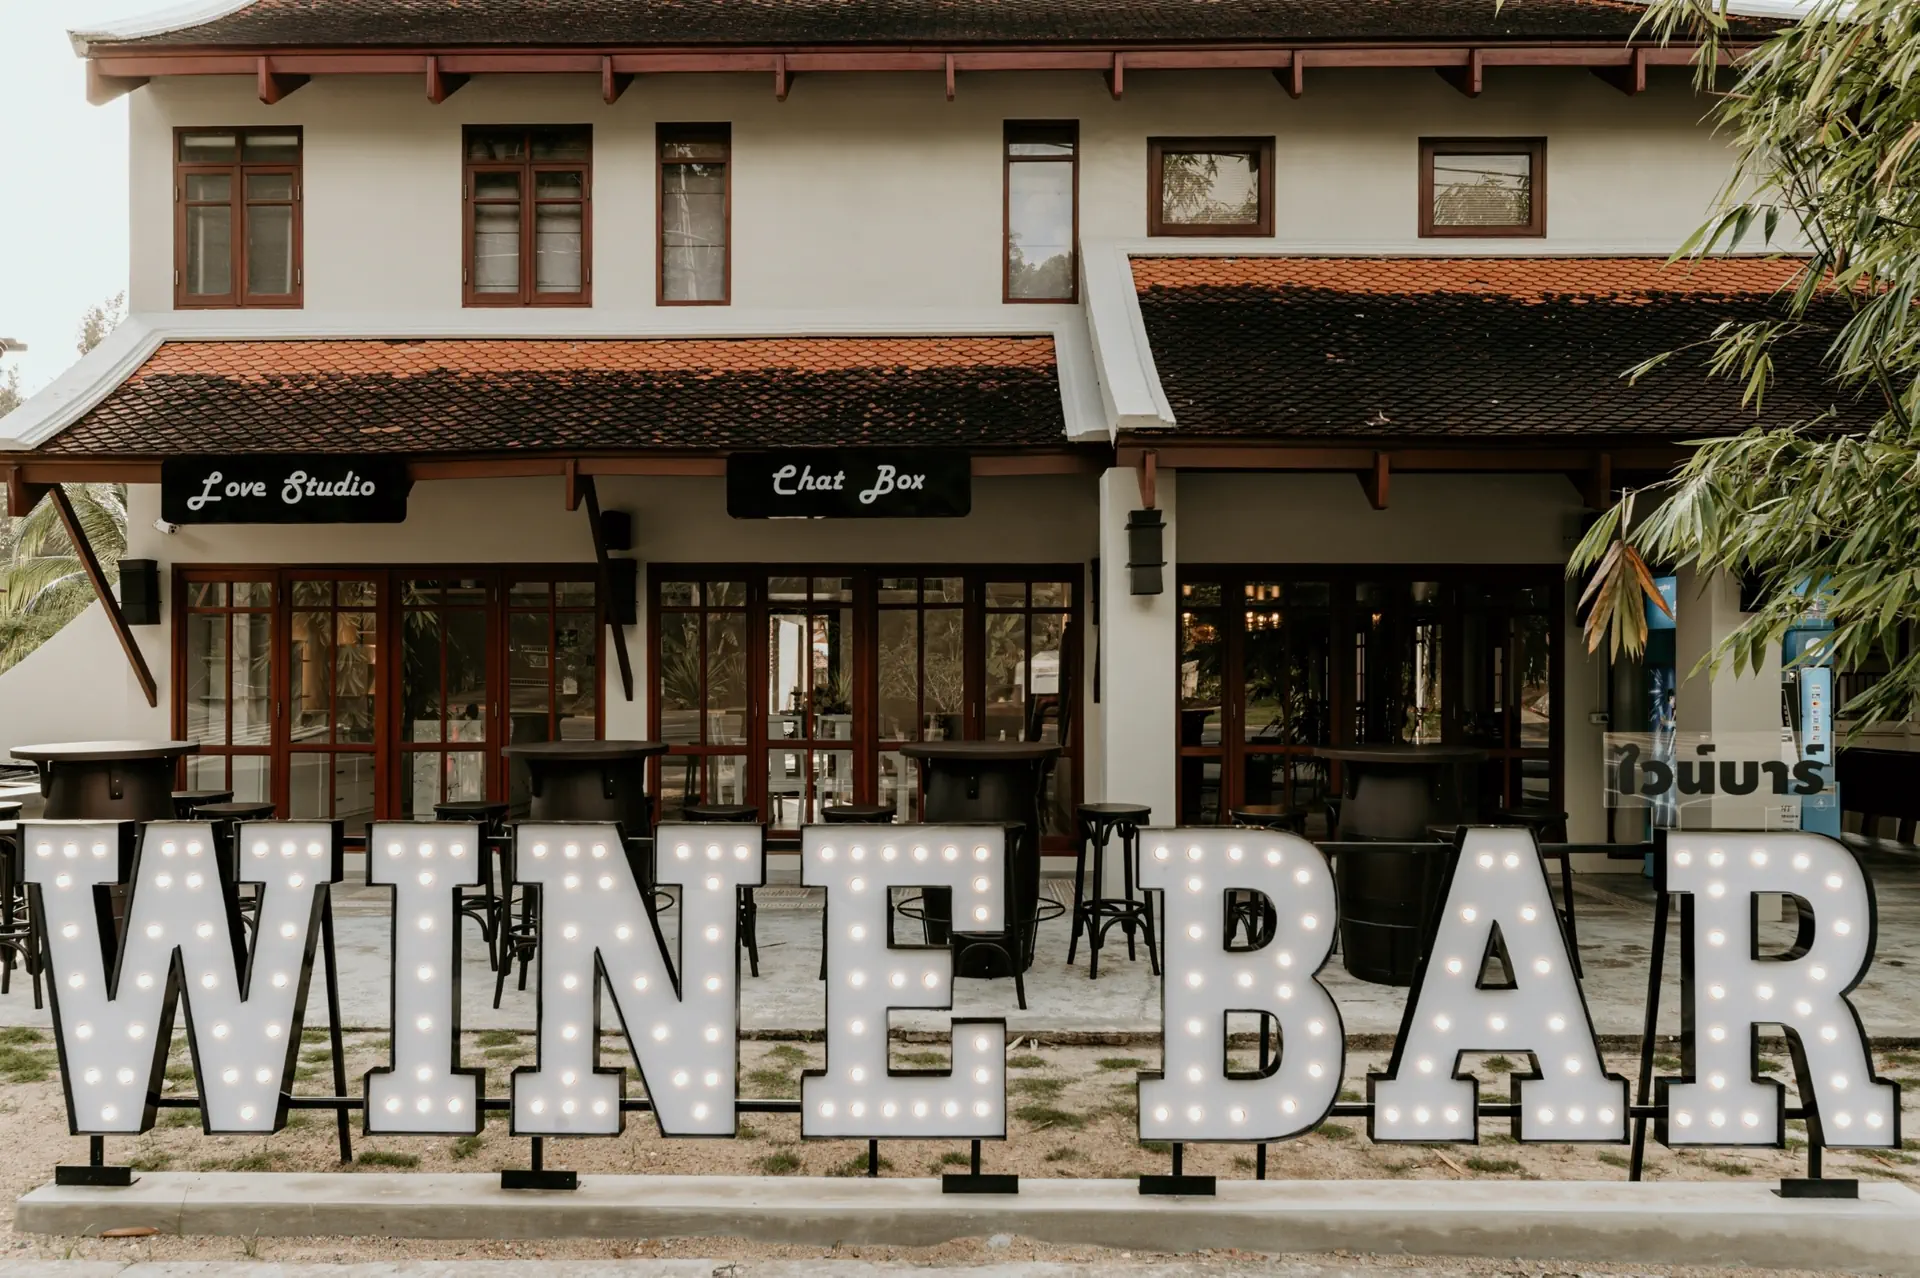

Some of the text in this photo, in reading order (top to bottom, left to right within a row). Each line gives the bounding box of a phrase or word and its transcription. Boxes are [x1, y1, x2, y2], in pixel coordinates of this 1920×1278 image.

[187, 470, 376, 510] Love Studio
[772, 464, 926, 504] Chat Box
[1613, 743, 1825, 796] ไวน์บาร์
[18, 821, 1900, 1148] WINE BAR
